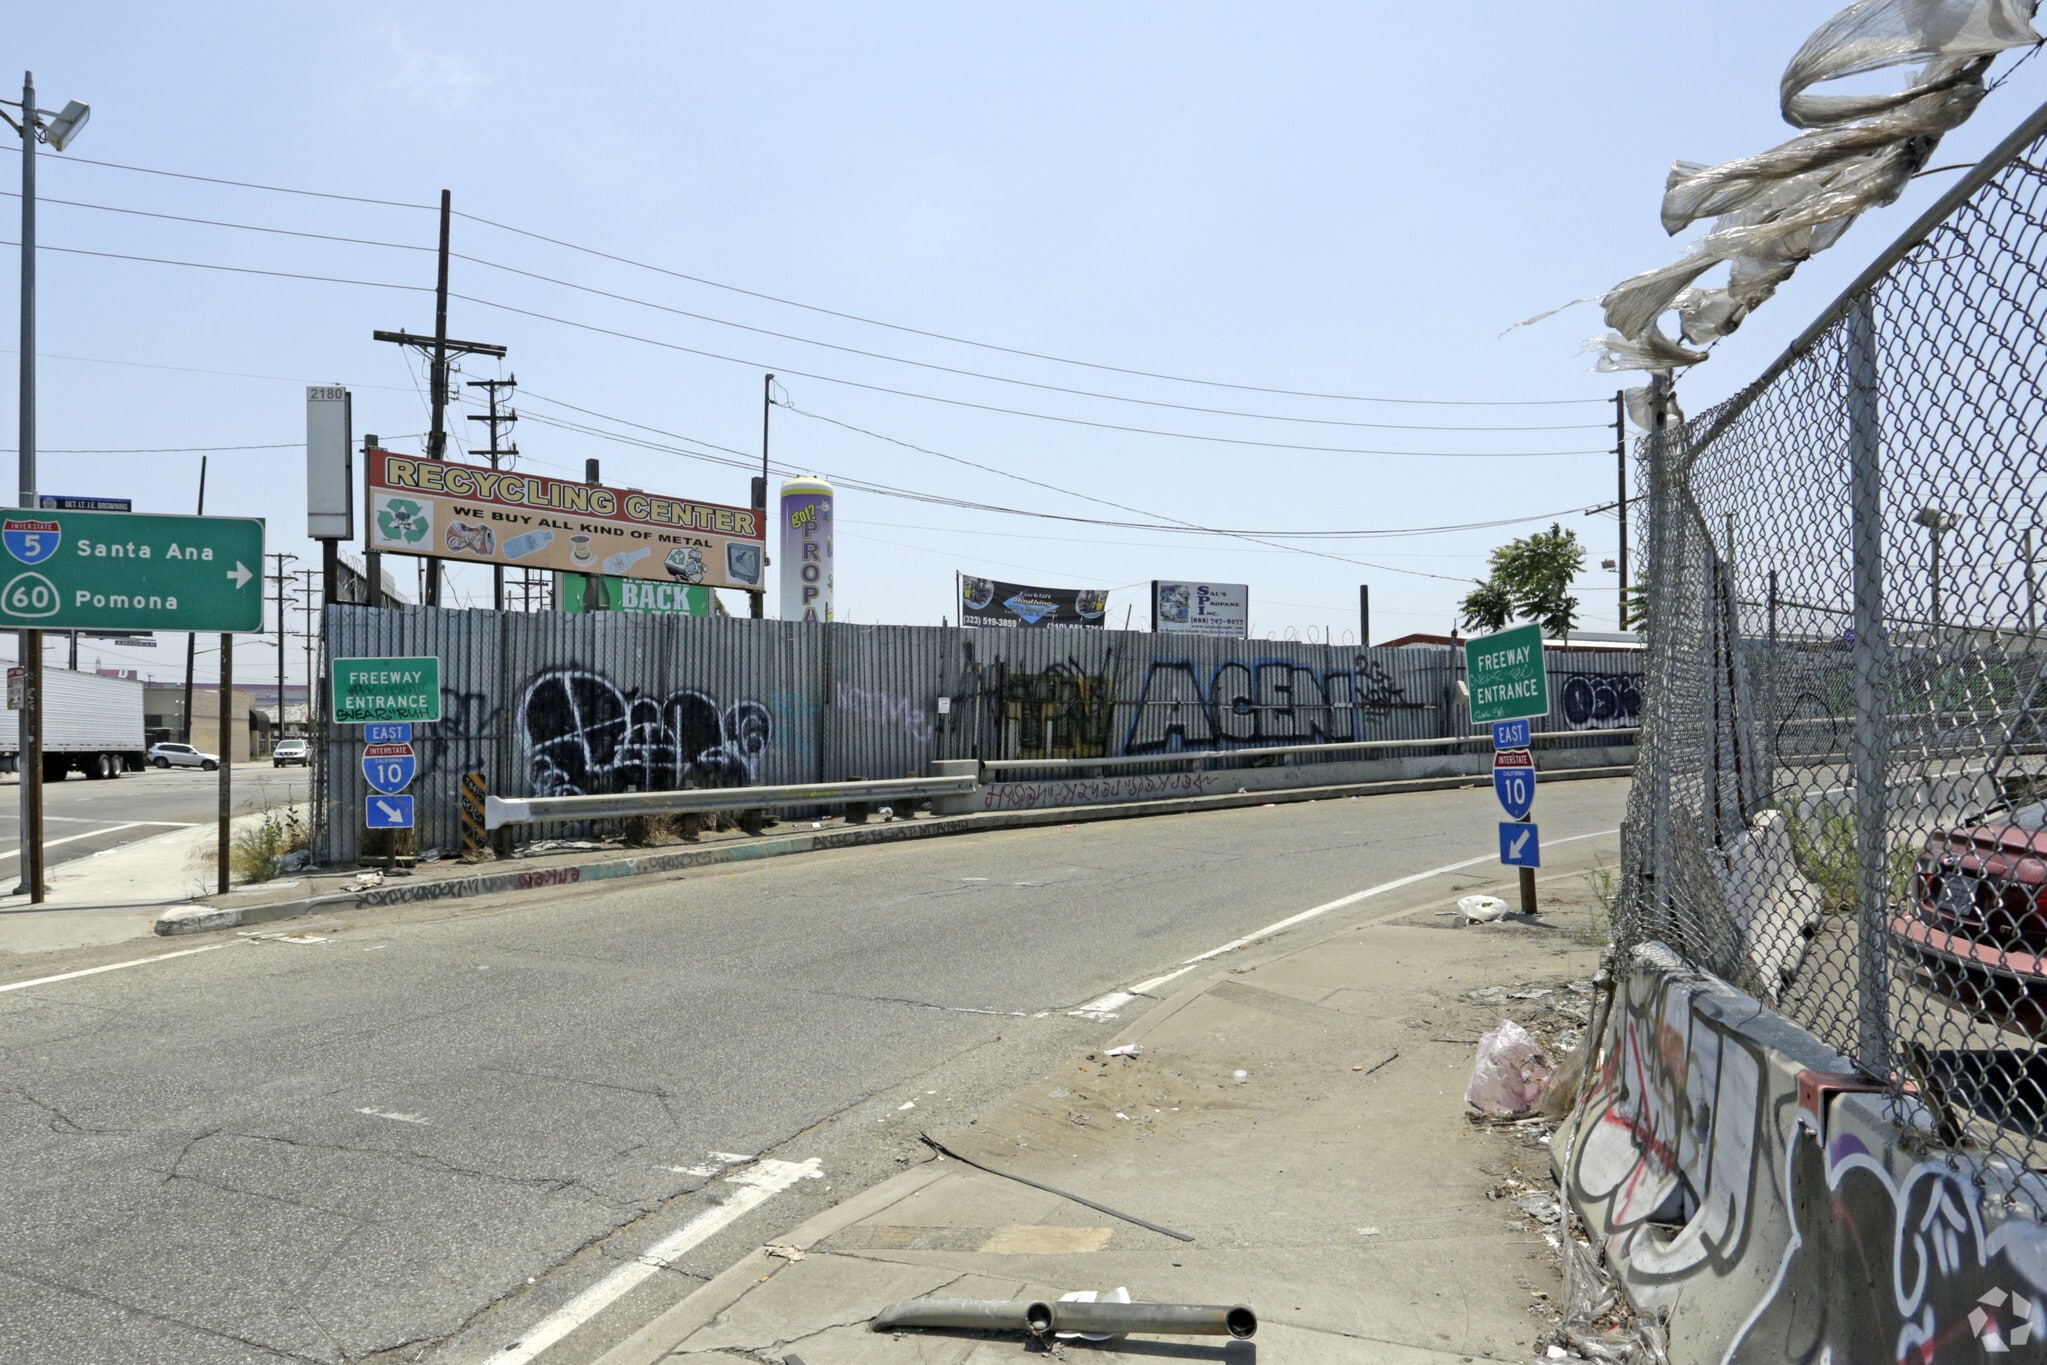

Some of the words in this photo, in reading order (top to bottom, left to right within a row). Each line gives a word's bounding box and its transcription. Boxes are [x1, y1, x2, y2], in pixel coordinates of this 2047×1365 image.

[310, 388, 342, 400] 2180
[387, 457, 616, 514] RECYCLING
[625, 495, 756, 536] CENTER
[791, 504, 816, 529] got?
[11, 523, 52, 531] INTERSTATE
[453, 506, 484, 519] WE
[492, 511, 532, 525] BUY
[538, 517, 573, 531] ALL
[580, 523, 624, 537] KIND
[630, 530, 652, 540] OF
[657, 534, 712, 549] METAL
[24, 534, 41, 557] 5
[77, 539, 152, 559] Santa
[165, 543, 214, 561] Ana
[12, 586, 49, 608] 60
[75, 590, 178, 610] Pomona
[622, 583, 690, 611] BACK
[1197, 596, 1240, 607] PROPANE
[963, 615, 981, 626] (323)
[1478, 645, 1530, 672] FREEWAY
[349, 671, 423, 684] FREEWAY
[1477, 679, 1538, 705] ENTRANCE
[345, 695, 428, 709] ENTRANCE
[372, 727, 403, 739] EAST
[1499, 725, 1523, 744] EAST
[369, 746, 407, 755] INTERSTATE
[1498, 754, 1528, 765] INTERSTATE
[377, 764, 402, 783] 10
[1505, 779, 1526, 805] 10
